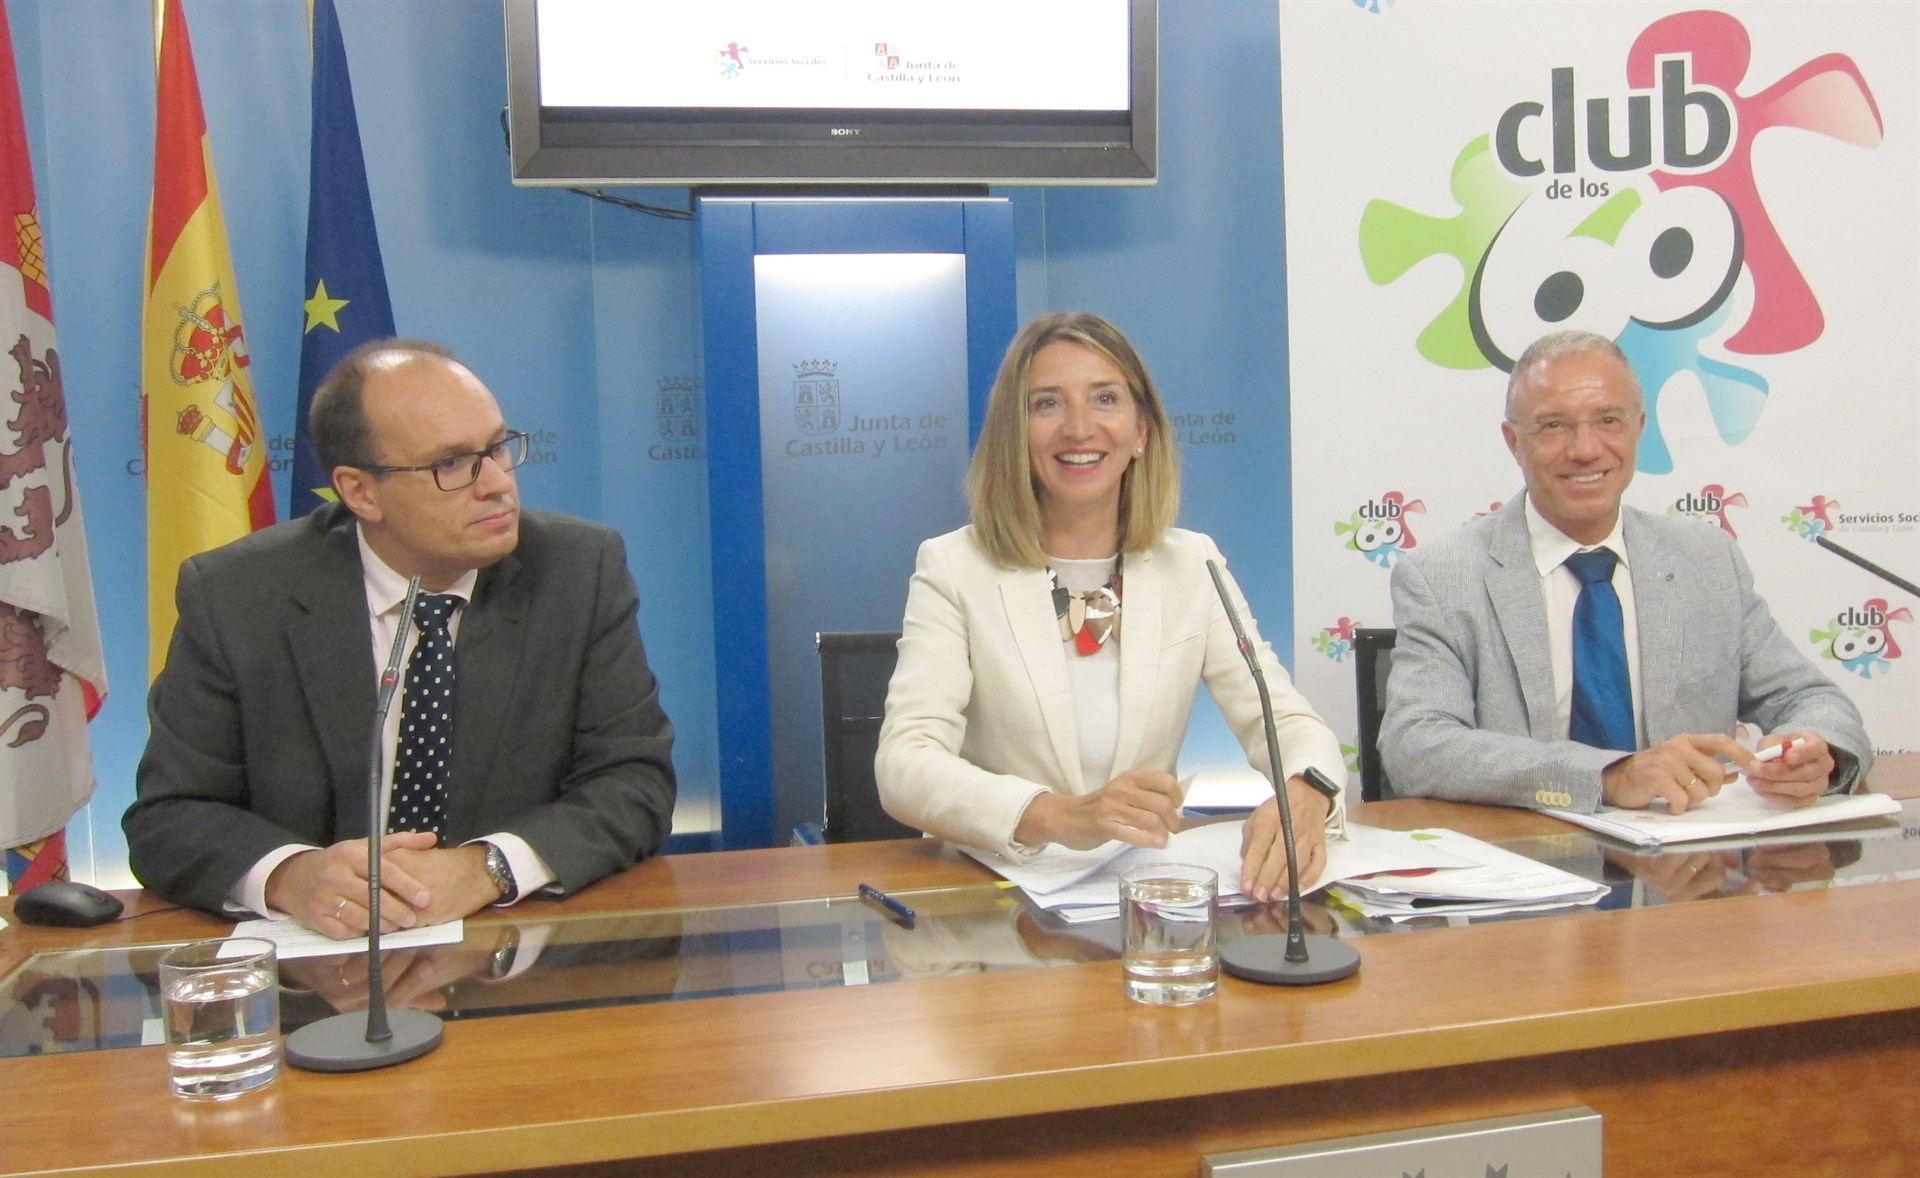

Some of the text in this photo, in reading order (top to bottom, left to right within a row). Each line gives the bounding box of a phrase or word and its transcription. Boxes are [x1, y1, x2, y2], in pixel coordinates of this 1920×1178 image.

[1495, 59, 1731, 177] club
[830, 128, 861, 136] SONY
[1545, 177, 1610, 200] de los
[1468, 184, 1746, 376] 60
[849, 411, 947, 433] Junta de
[785, 433, 946, 459] Castilla y León
[1187, 427, 1236, 445] León
[1358, 499, 1401, 519] club
[1675, 492, 1721, 512] club
[1839, 512, 1894, 524] Servicios
[1837, 606, 1885, 627] club
